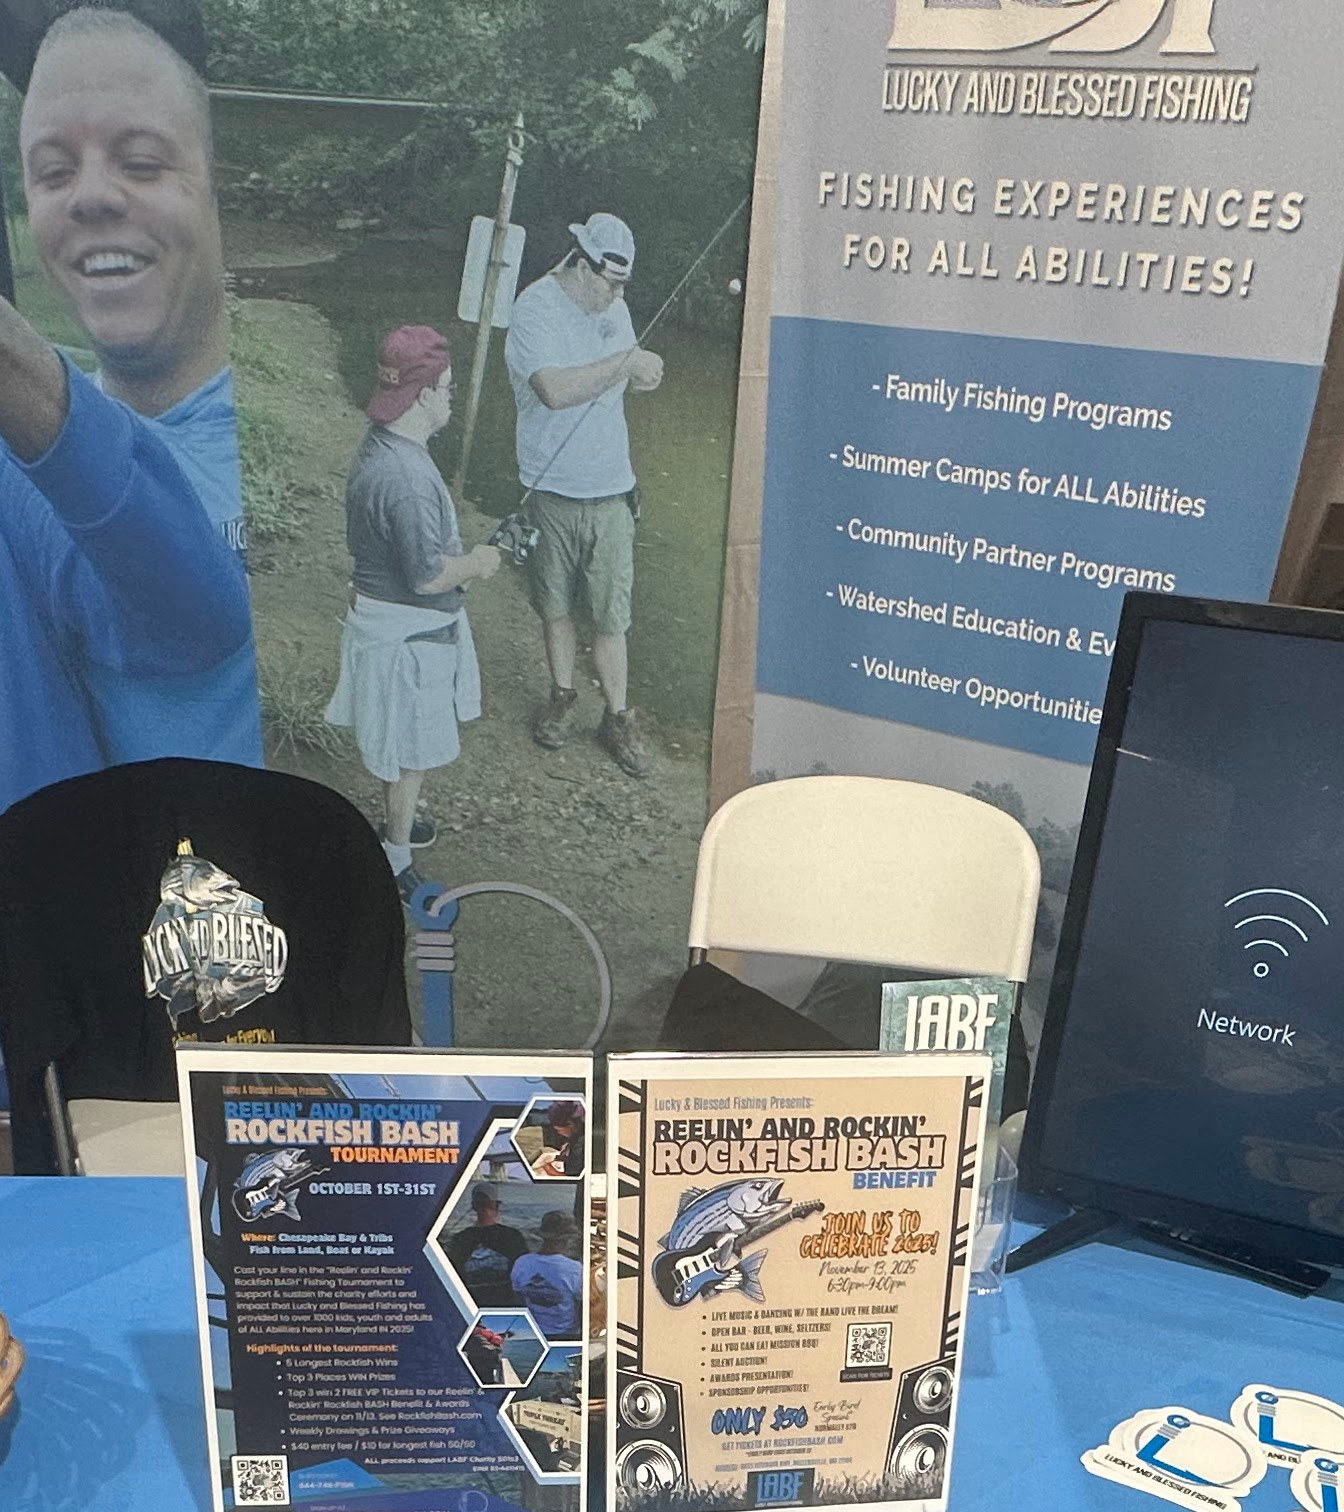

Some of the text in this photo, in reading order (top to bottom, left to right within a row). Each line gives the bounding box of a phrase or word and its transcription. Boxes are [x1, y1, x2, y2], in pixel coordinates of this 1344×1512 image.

[882, 71, 1252, 122] LUCKY AND BLESSED FISHING
[817, 171, 1305, 232] FISHING EXPERIENCES
[843, 234, 1255, 295] FOR ALL ABILITIES!
[886, 375, 1172, 430] Family Fishing Programs
[843, 446, 1206, 517] Summer Camps for ALL Abilities
[848, 520, 1175, 591] Community Partner Programs
[839, 584, 947, 625] Watershed
[952, 606, 1060, 646] Education
[1065, 628, 1082, 651] &
[863, 657, 1103, 724] Volunteer Opportunitie
[1196, 1008, 1297, 1047] Network
[224, 1102, 442, 1120] REELIN' AND ROCKIN'
[655, 1098, 682, 1112] Lucky
[684, 1098, 692, 1110] &
[694, 1098, 730, 1110] Blessed
[733, 1097, 767, 1110] Fishing
[226, 1119, 459, 1145] ROCKFISH BASH
[655, 1116, 926, 1141] REELIN' AND ROCKIN'
[331, 1147, 459, 1163] TOURNAMENT
[652, 1134, 946, 1175] ROCKFISH BASH
[309, 1183, 436, 1195] OCTOBER 1ST-31ST
[853, 1171, 936, 1190] BENEFIT
[822, 1210, 921, 1234] JOIN US TO
[241, 1234, 393, 1243] Where: Chesapeake Bay & Tribs
[250, 1246, 270, 1254] Fish
[272, 1246, 295, 1254] from
[298, 1247, 324, 1256] Land,
[327, 1246, 348, 1254] Boat
[364, 1246, 394, 1256] Kayak
[800, 1232, 940, 1259] CELEBRATE 2025!
[820, 1262, 867, 1276] November
[892, 1260, 918, 1275] 2025
[712, 1312, 727, 1321] LIVE
[729, 1310, 752, 1320] MUSIC
[712, 1327, 729, 1336] OPEN
[247, 1344, 399, 1354] Highlights of the tournament:
[710, 1373, 740, 1383] AWARDS
[711, 1405, 808, 1435] ONLY $50
